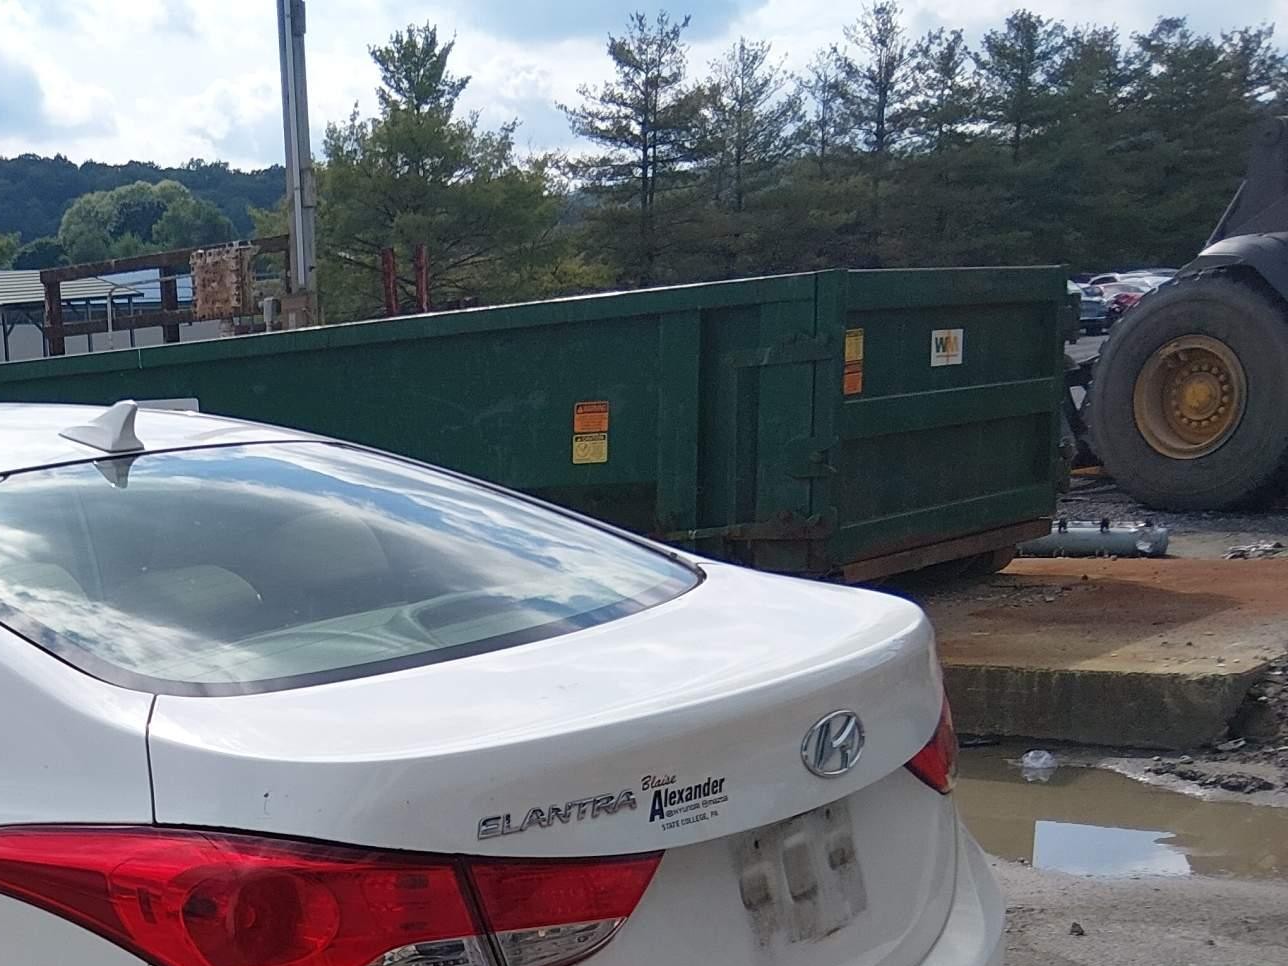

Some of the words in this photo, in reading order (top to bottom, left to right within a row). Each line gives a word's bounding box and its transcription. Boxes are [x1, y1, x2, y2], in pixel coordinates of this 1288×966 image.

[641, 775, 676, 791] Blaise
[649, 777, 725, 822] Alexander
[477, 790, 637, 840] ELANTRA
[661, 820, 679, 831] STATE
